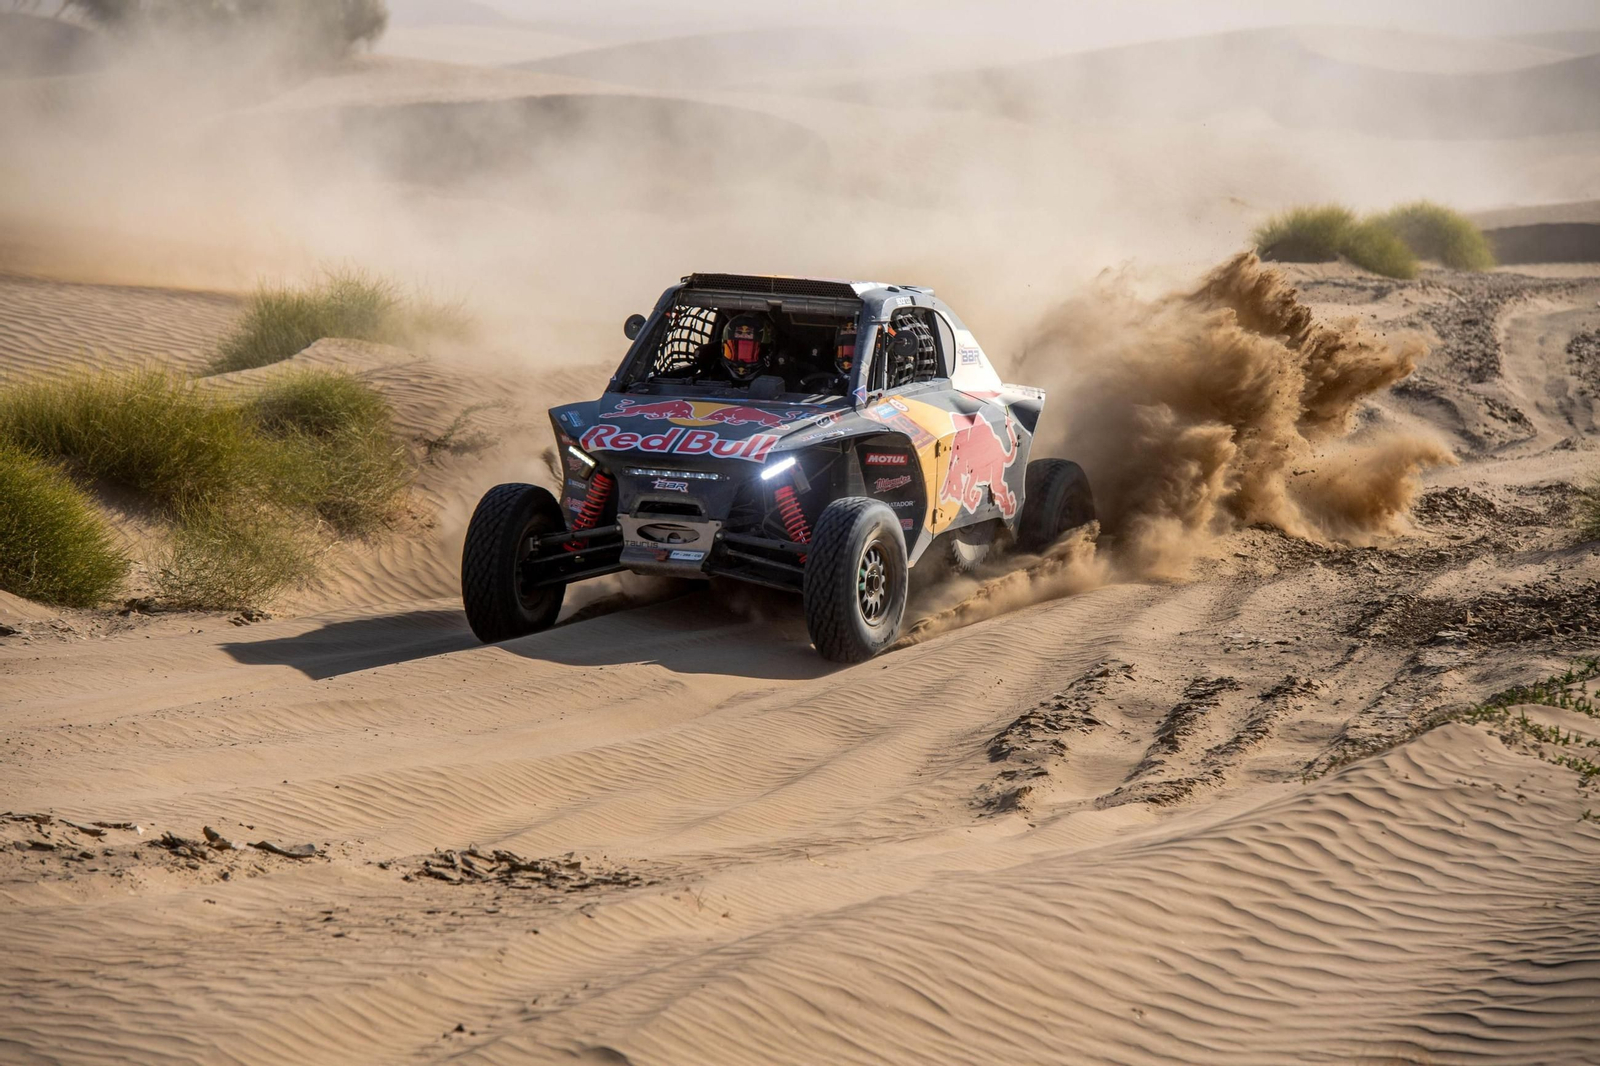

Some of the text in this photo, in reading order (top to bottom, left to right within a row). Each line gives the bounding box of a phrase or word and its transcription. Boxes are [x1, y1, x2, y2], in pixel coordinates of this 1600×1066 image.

[579, 424, 782, 464] Red Bull
[868, 455, 905, 464] MOTUL
